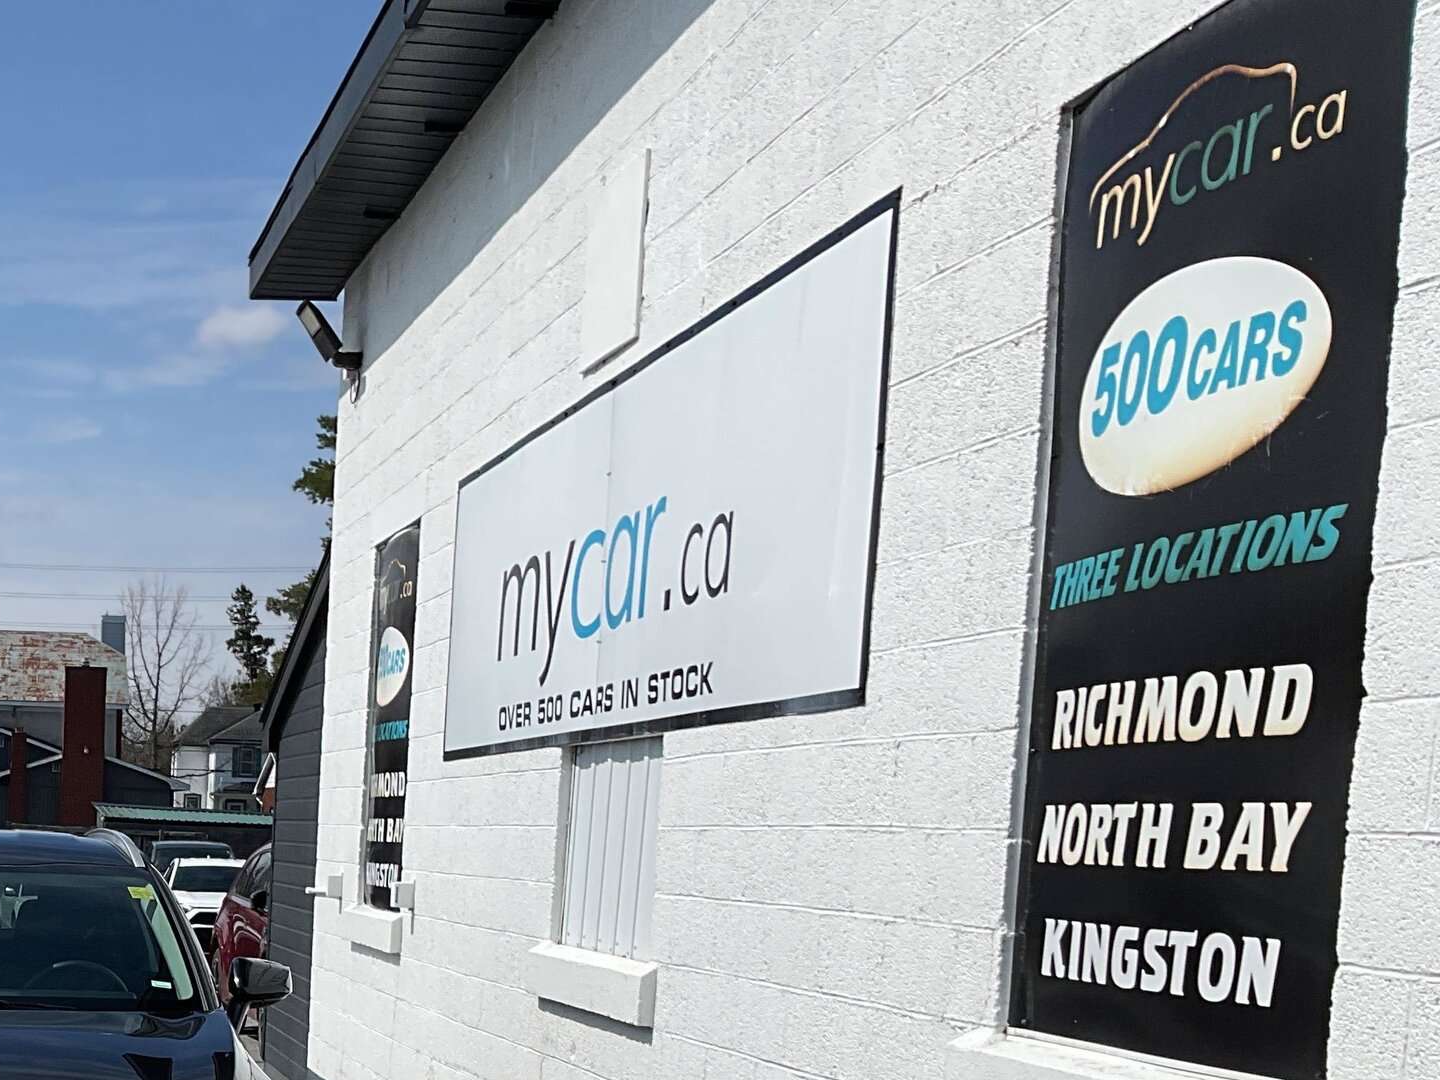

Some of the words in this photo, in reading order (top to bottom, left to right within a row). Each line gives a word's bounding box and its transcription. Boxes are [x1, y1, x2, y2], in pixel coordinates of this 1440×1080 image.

[1095, 89, 1348, 249] mycar.ca
[497, 495, 734, 687] mycar.ca
[1049, 547, 1127, 611] THREE
[1127, 503, 1350, 594] LOCATIONS
[498, 700, 533, 732] OVER
[537, 694, 563, 725] 500
[569, 682, 614, 719] CARS
[621, 677, 639, 709] IN
[647, 661, 714, 704] STOCK
[1051, 663, 1314, 751] RICHMOND
[1036, 800, 1174, 871] NORTH
[1182, 801, 1313, 873] BAY
[1040, 917, 1282, 1008] KINGSTON
